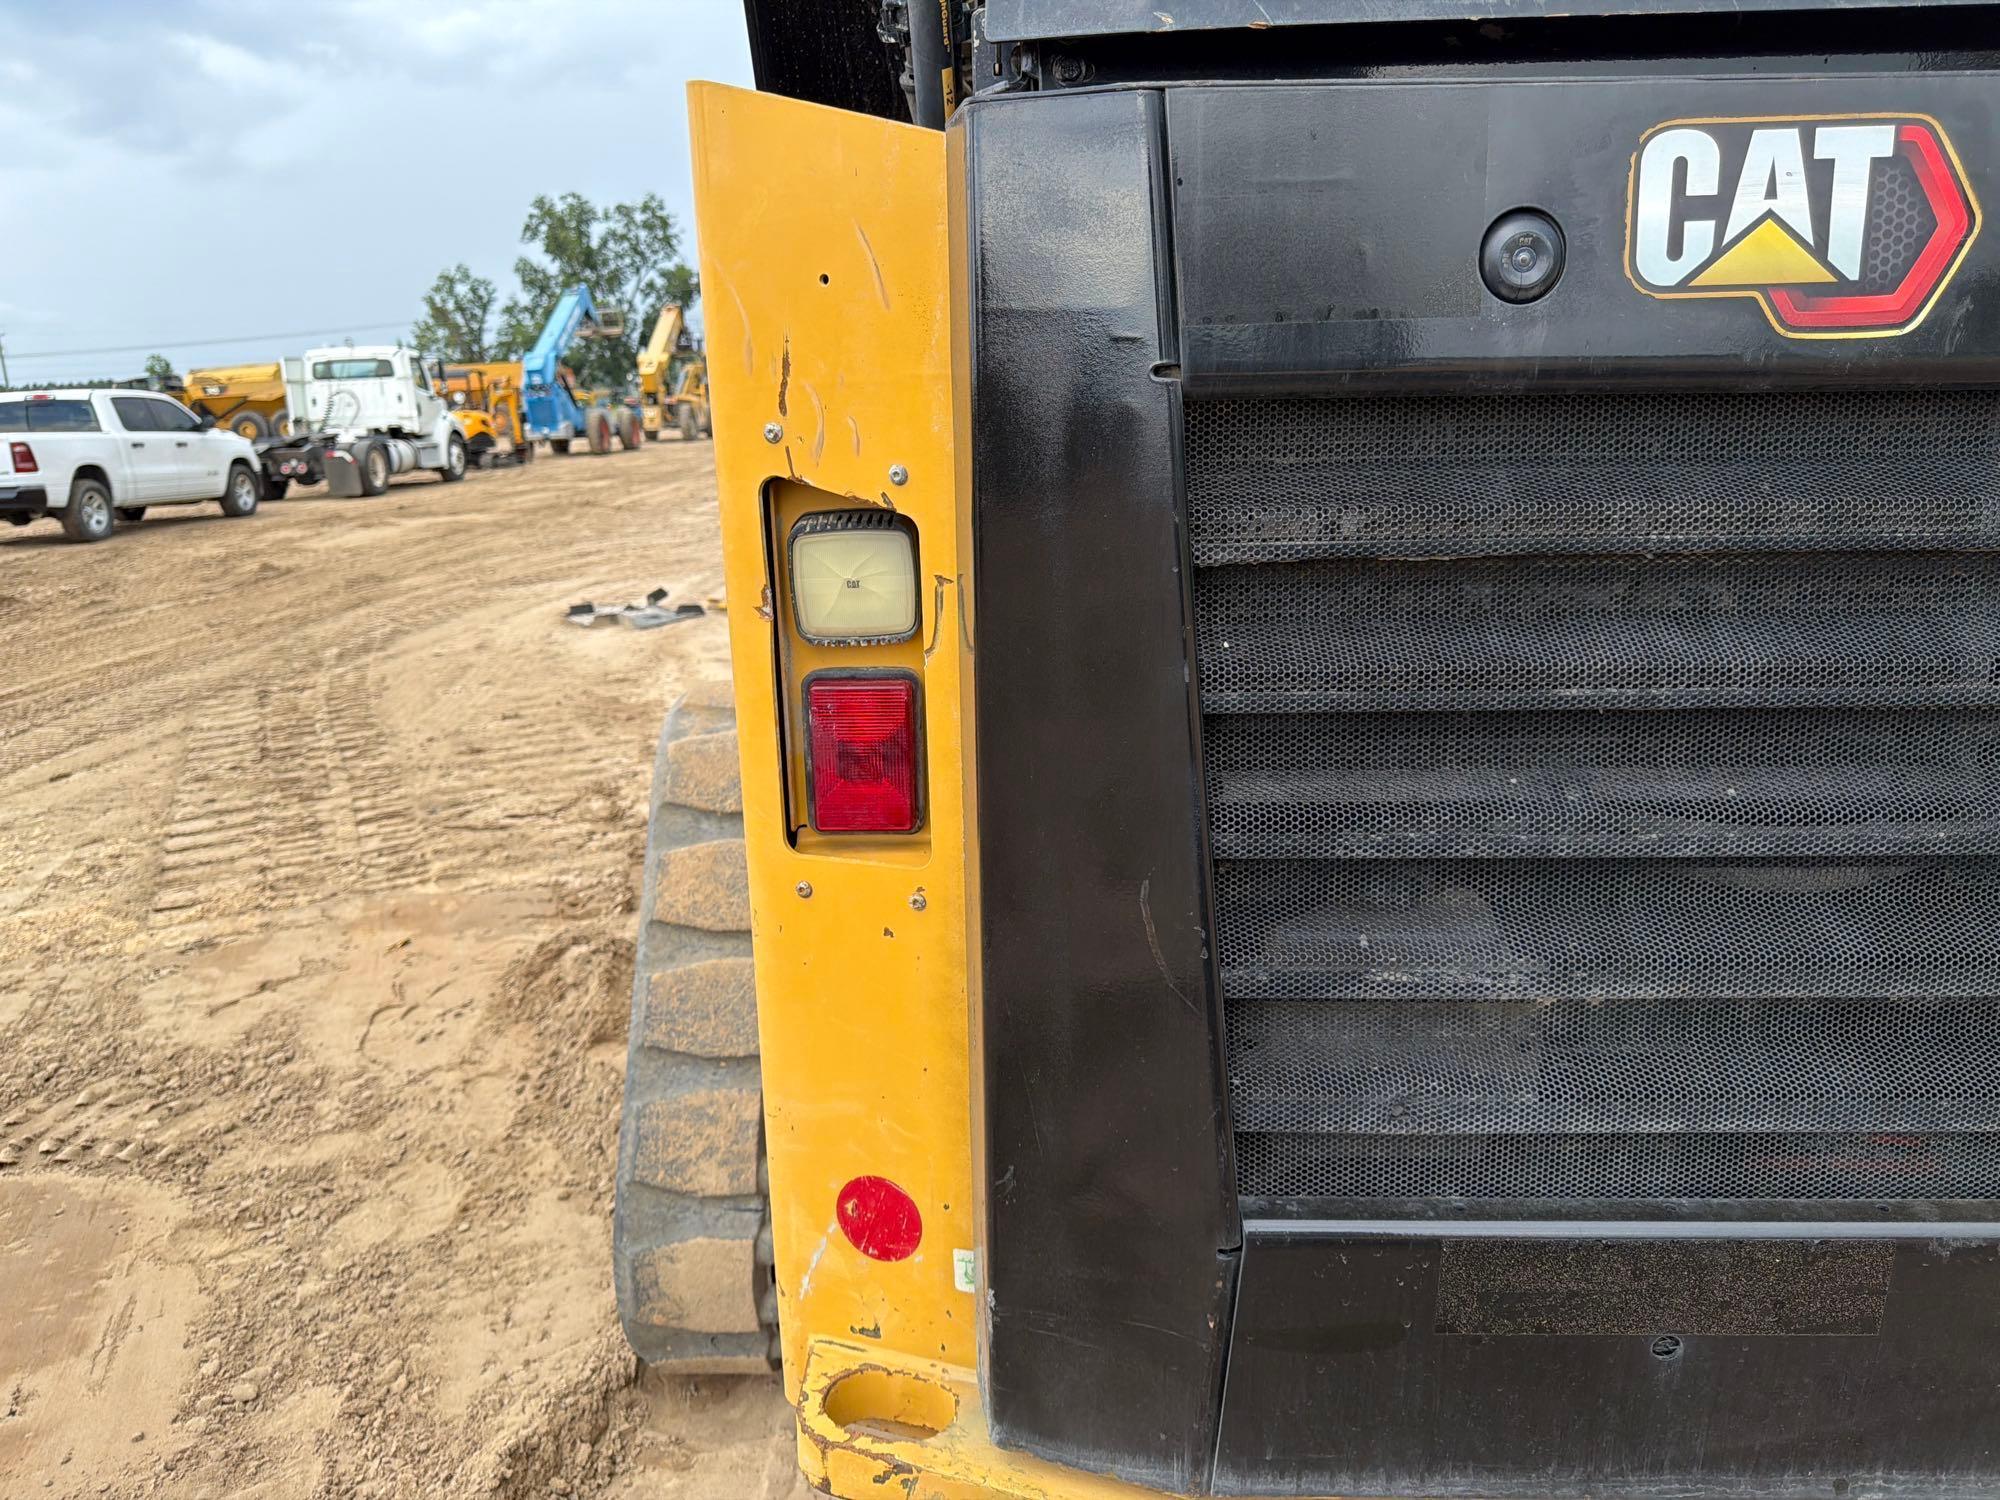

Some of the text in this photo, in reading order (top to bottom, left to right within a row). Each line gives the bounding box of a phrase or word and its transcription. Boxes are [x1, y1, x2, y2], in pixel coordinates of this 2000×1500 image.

[1636, 125, 1895, 286] CAT
[1520, 237, 1533, 246] CAT
[846, 580, 860, 588] CAT
